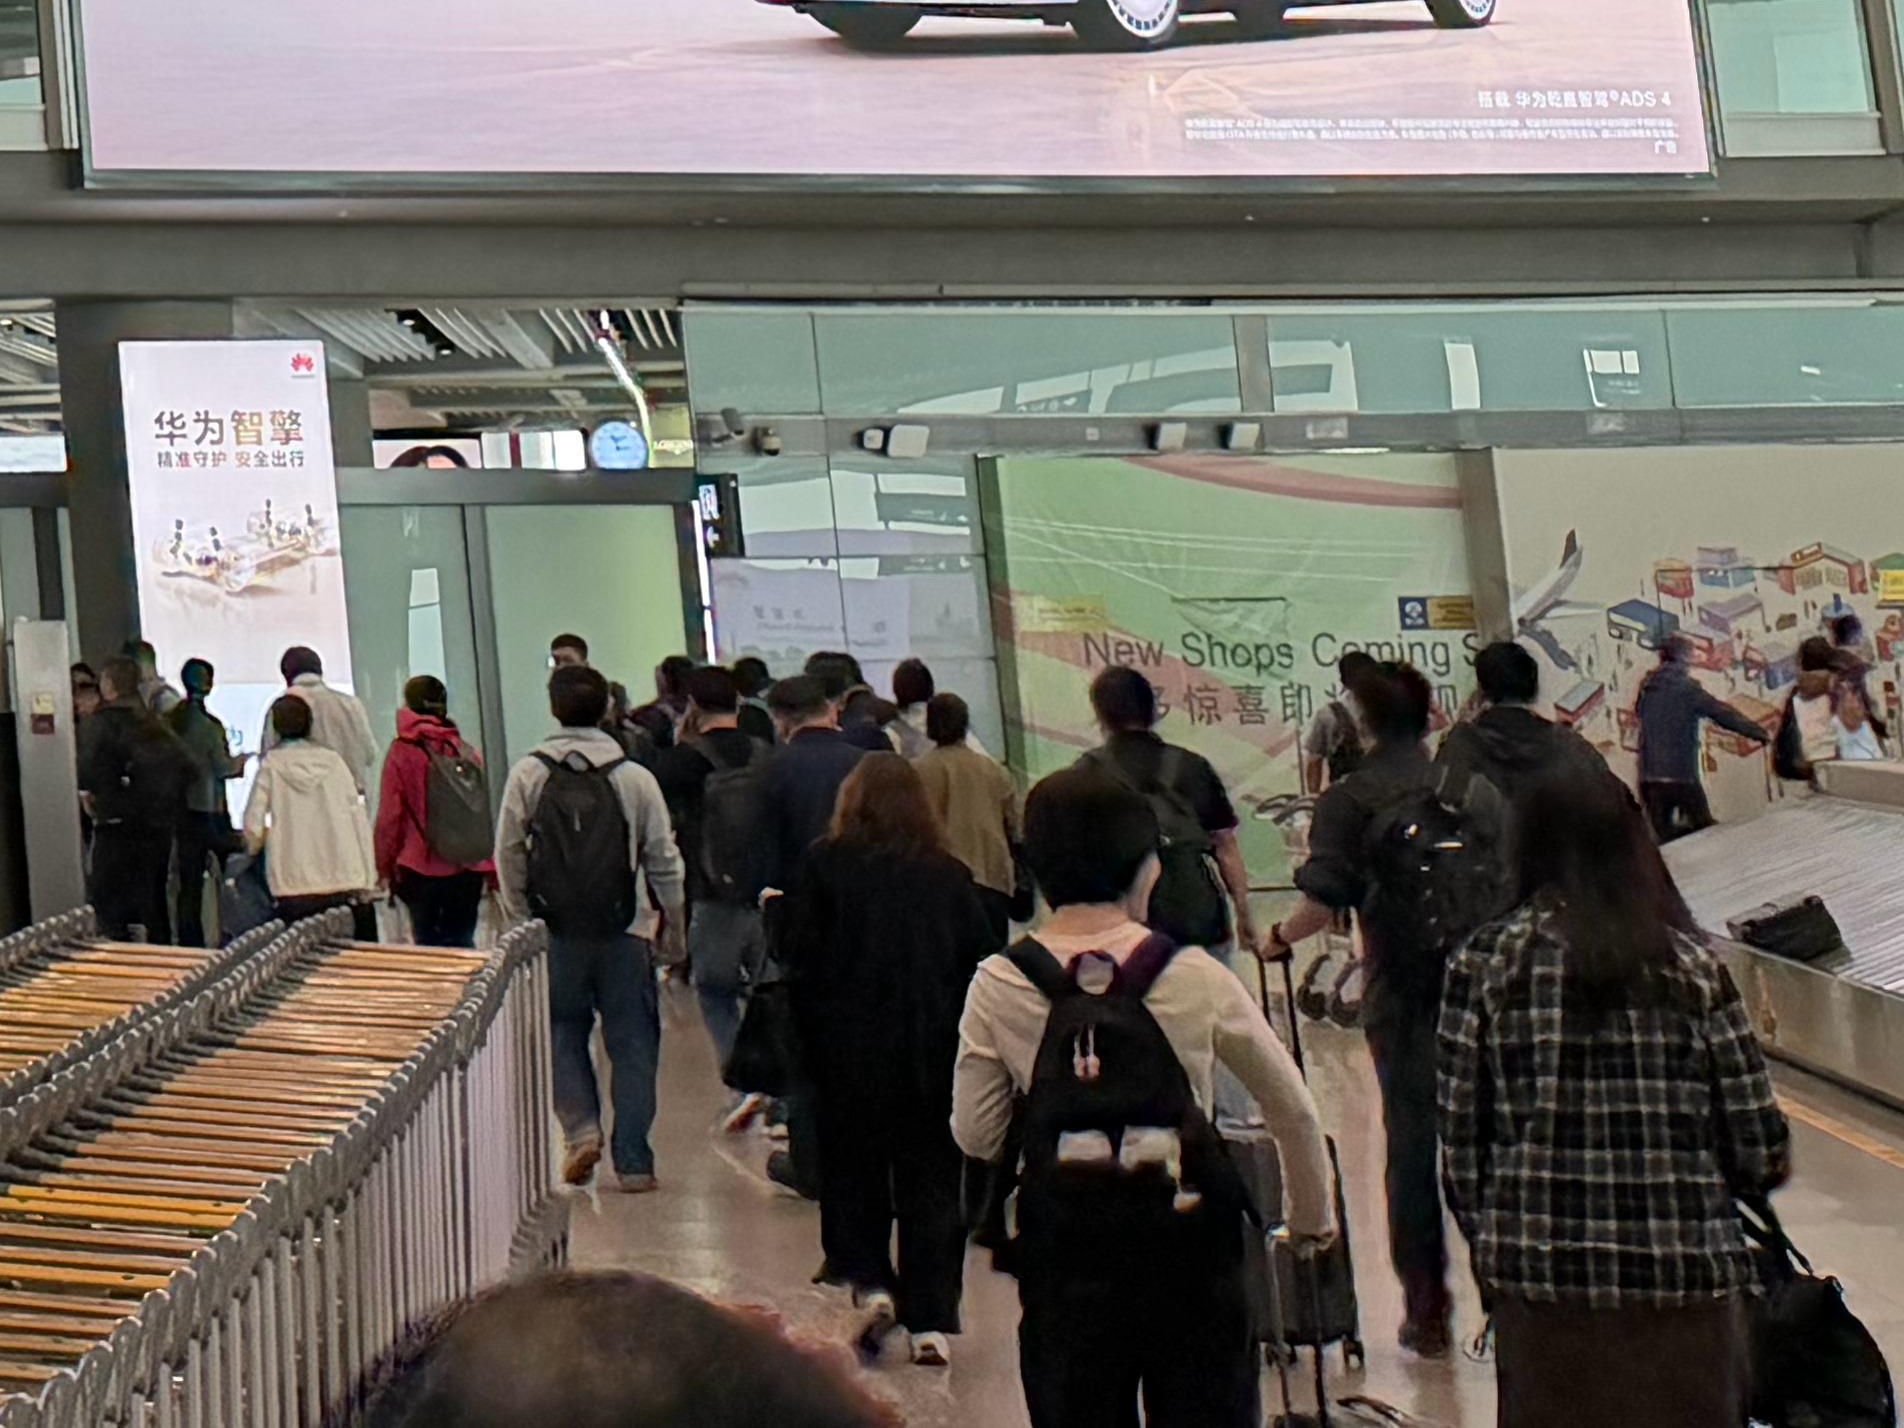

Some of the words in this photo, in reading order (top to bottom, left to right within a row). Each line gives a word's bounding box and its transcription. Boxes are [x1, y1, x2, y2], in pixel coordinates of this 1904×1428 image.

[154, 409, 304, 447] 华为智擎
[234, 449, 305, 469] 安全出行
[1081, 632, 1164, 667] New
[1181, 632, 1294, 676] Shops
